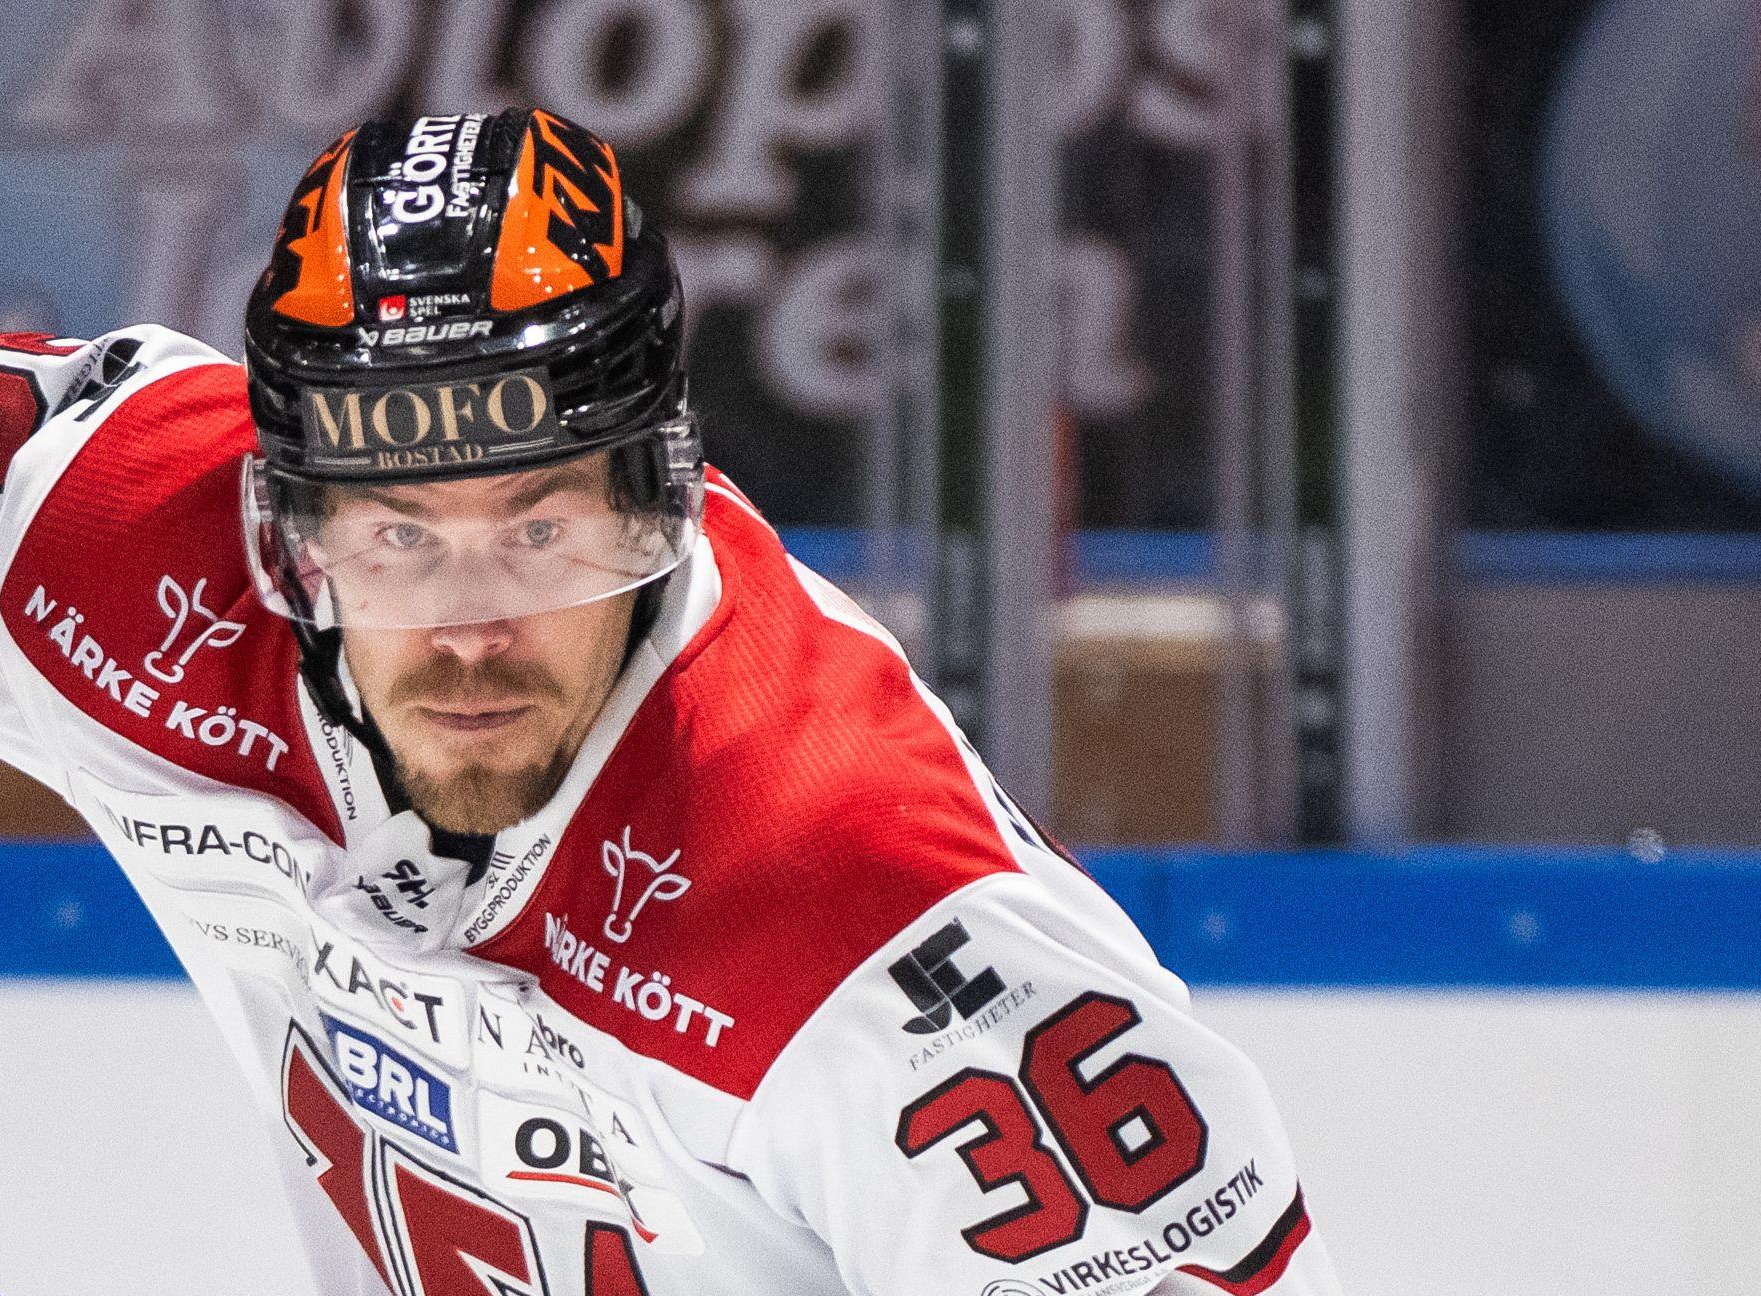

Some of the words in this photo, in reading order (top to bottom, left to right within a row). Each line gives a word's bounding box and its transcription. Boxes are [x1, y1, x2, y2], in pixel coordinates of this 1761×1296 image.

[382, 320, 494, 347] BAUER
[408, 293, 471, 307] SVENSKA
[312, 374, 548, 451] MOFO
[375, 443, 485, 471] BOSTAD
[24, 585, 160, 718] NÄRKE
[165, 700, 289, 772] KÖTT
[463, 833, 553, 944] BYGGPRODUKTION
[613, 966, 735, 1047] KÖTT
[908, 980, 1036, 1071] FASTIGHETER
[335, 1033, 449, 1133] BRL
[895, 990, 1210, 1265] 36
[1039, 1157, 1265, 1296] VIRKESLOGISTIK
